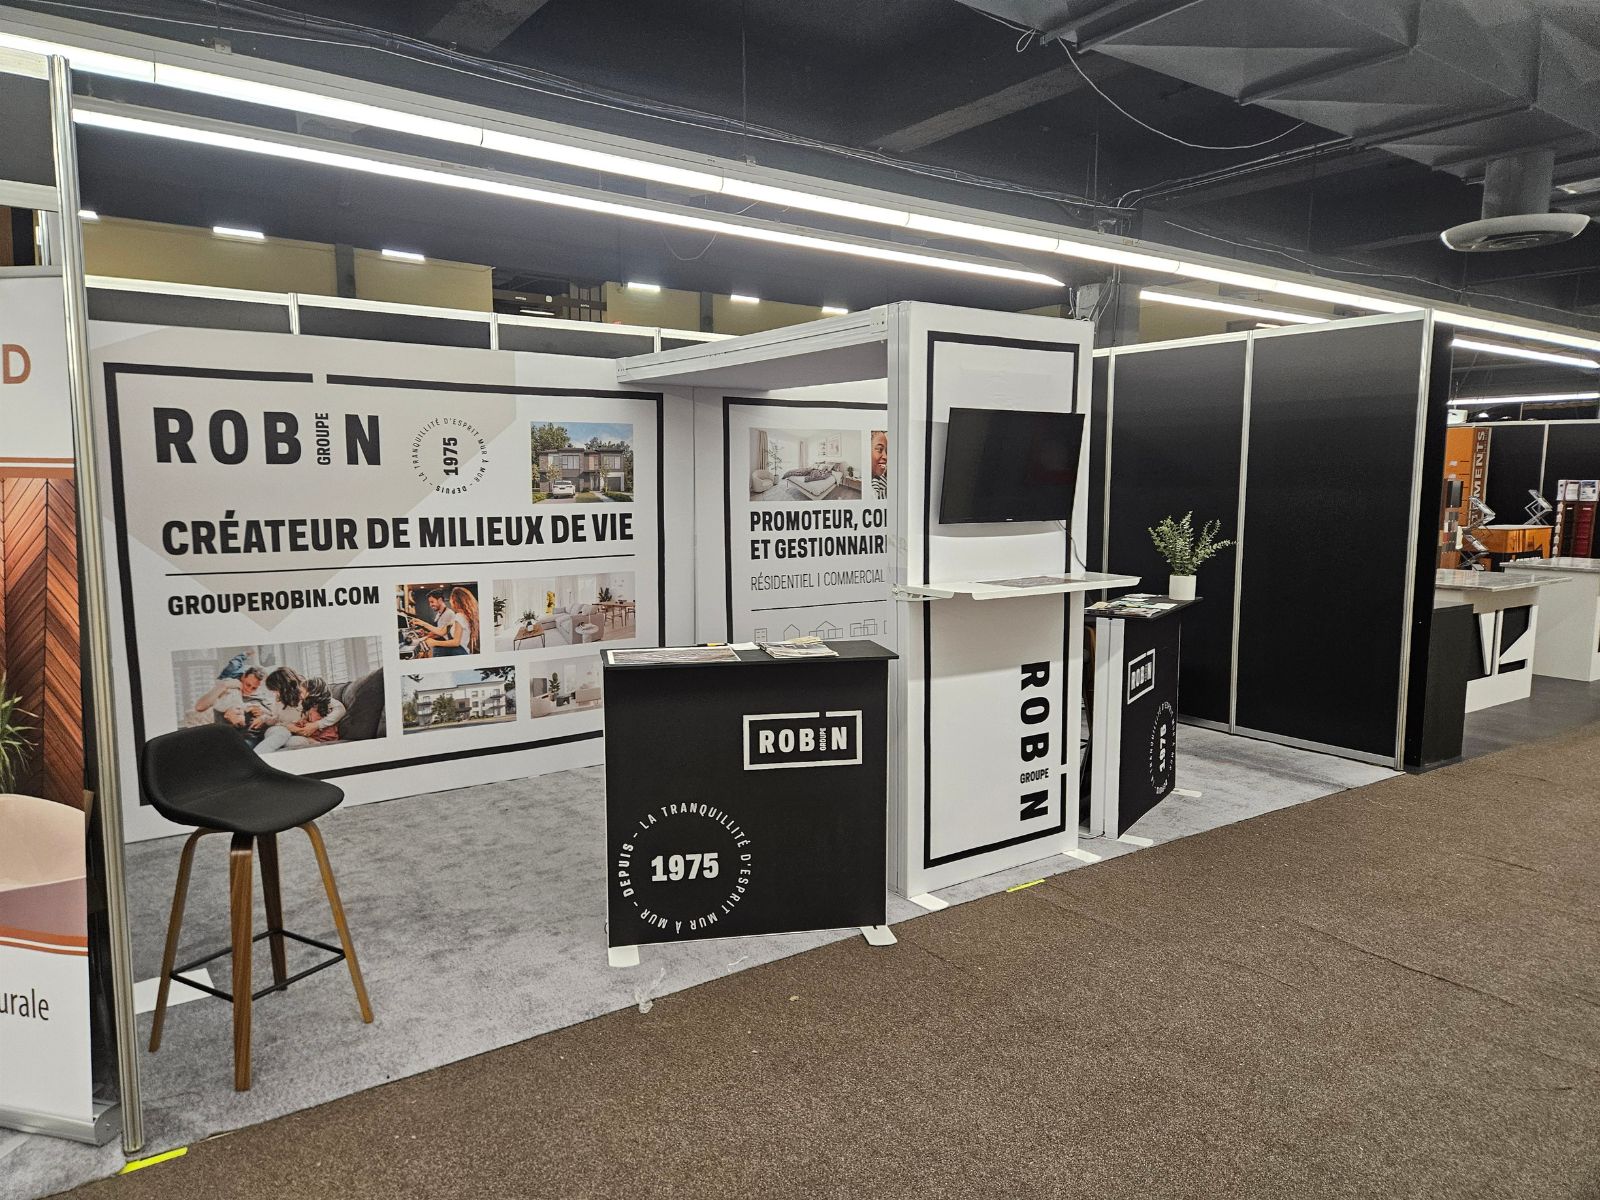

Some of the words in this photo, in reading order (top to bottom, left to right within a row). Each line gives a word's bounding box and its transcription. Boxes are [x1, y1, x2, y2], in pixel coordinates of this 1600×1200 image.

[2, 344, 31, 384] D
[315, 412, 331, 465] GROUPE
[442, 437, 459, 476] 1975
[435, 485, 468, 495] DEPUIS
[1472, 431, 1485, 521] MENTS
[162, 509, 359, 556] CRÉATEUR
[366, 517, 411, 549] DE
[418, 515, 545, 548] MILIEUX
[551, 514, 587, 543] DE
[591, 512, 634, 542] VIE
[750, 509, 858, 532] PROMOTEUR,
[862, 508, 887, 528] CO
[750, 539, 771, 560] ET
[775, 534, 888, 559] GESTIONNAIR
[750, 572, 814, 591] RÉSIDENTIEL
[823, 569, 886, 587] COMMERCIAL
[168, 586, 380, 616] GROUPEROBIN.COM
[1020, 768, 1049, 784] GROUPE
[639, 814, 657, 829] LA
[661, 803, 751, 848] TRANQUILLITÉ
[618, 843, 635, 897] DEPUIS
[651, 852, 719, 882] 1975
[721, 853, 752, 914] D'ESPRIT
[640, 908, 668, 929] MUR
[690, 912, 718, 930] MUR
